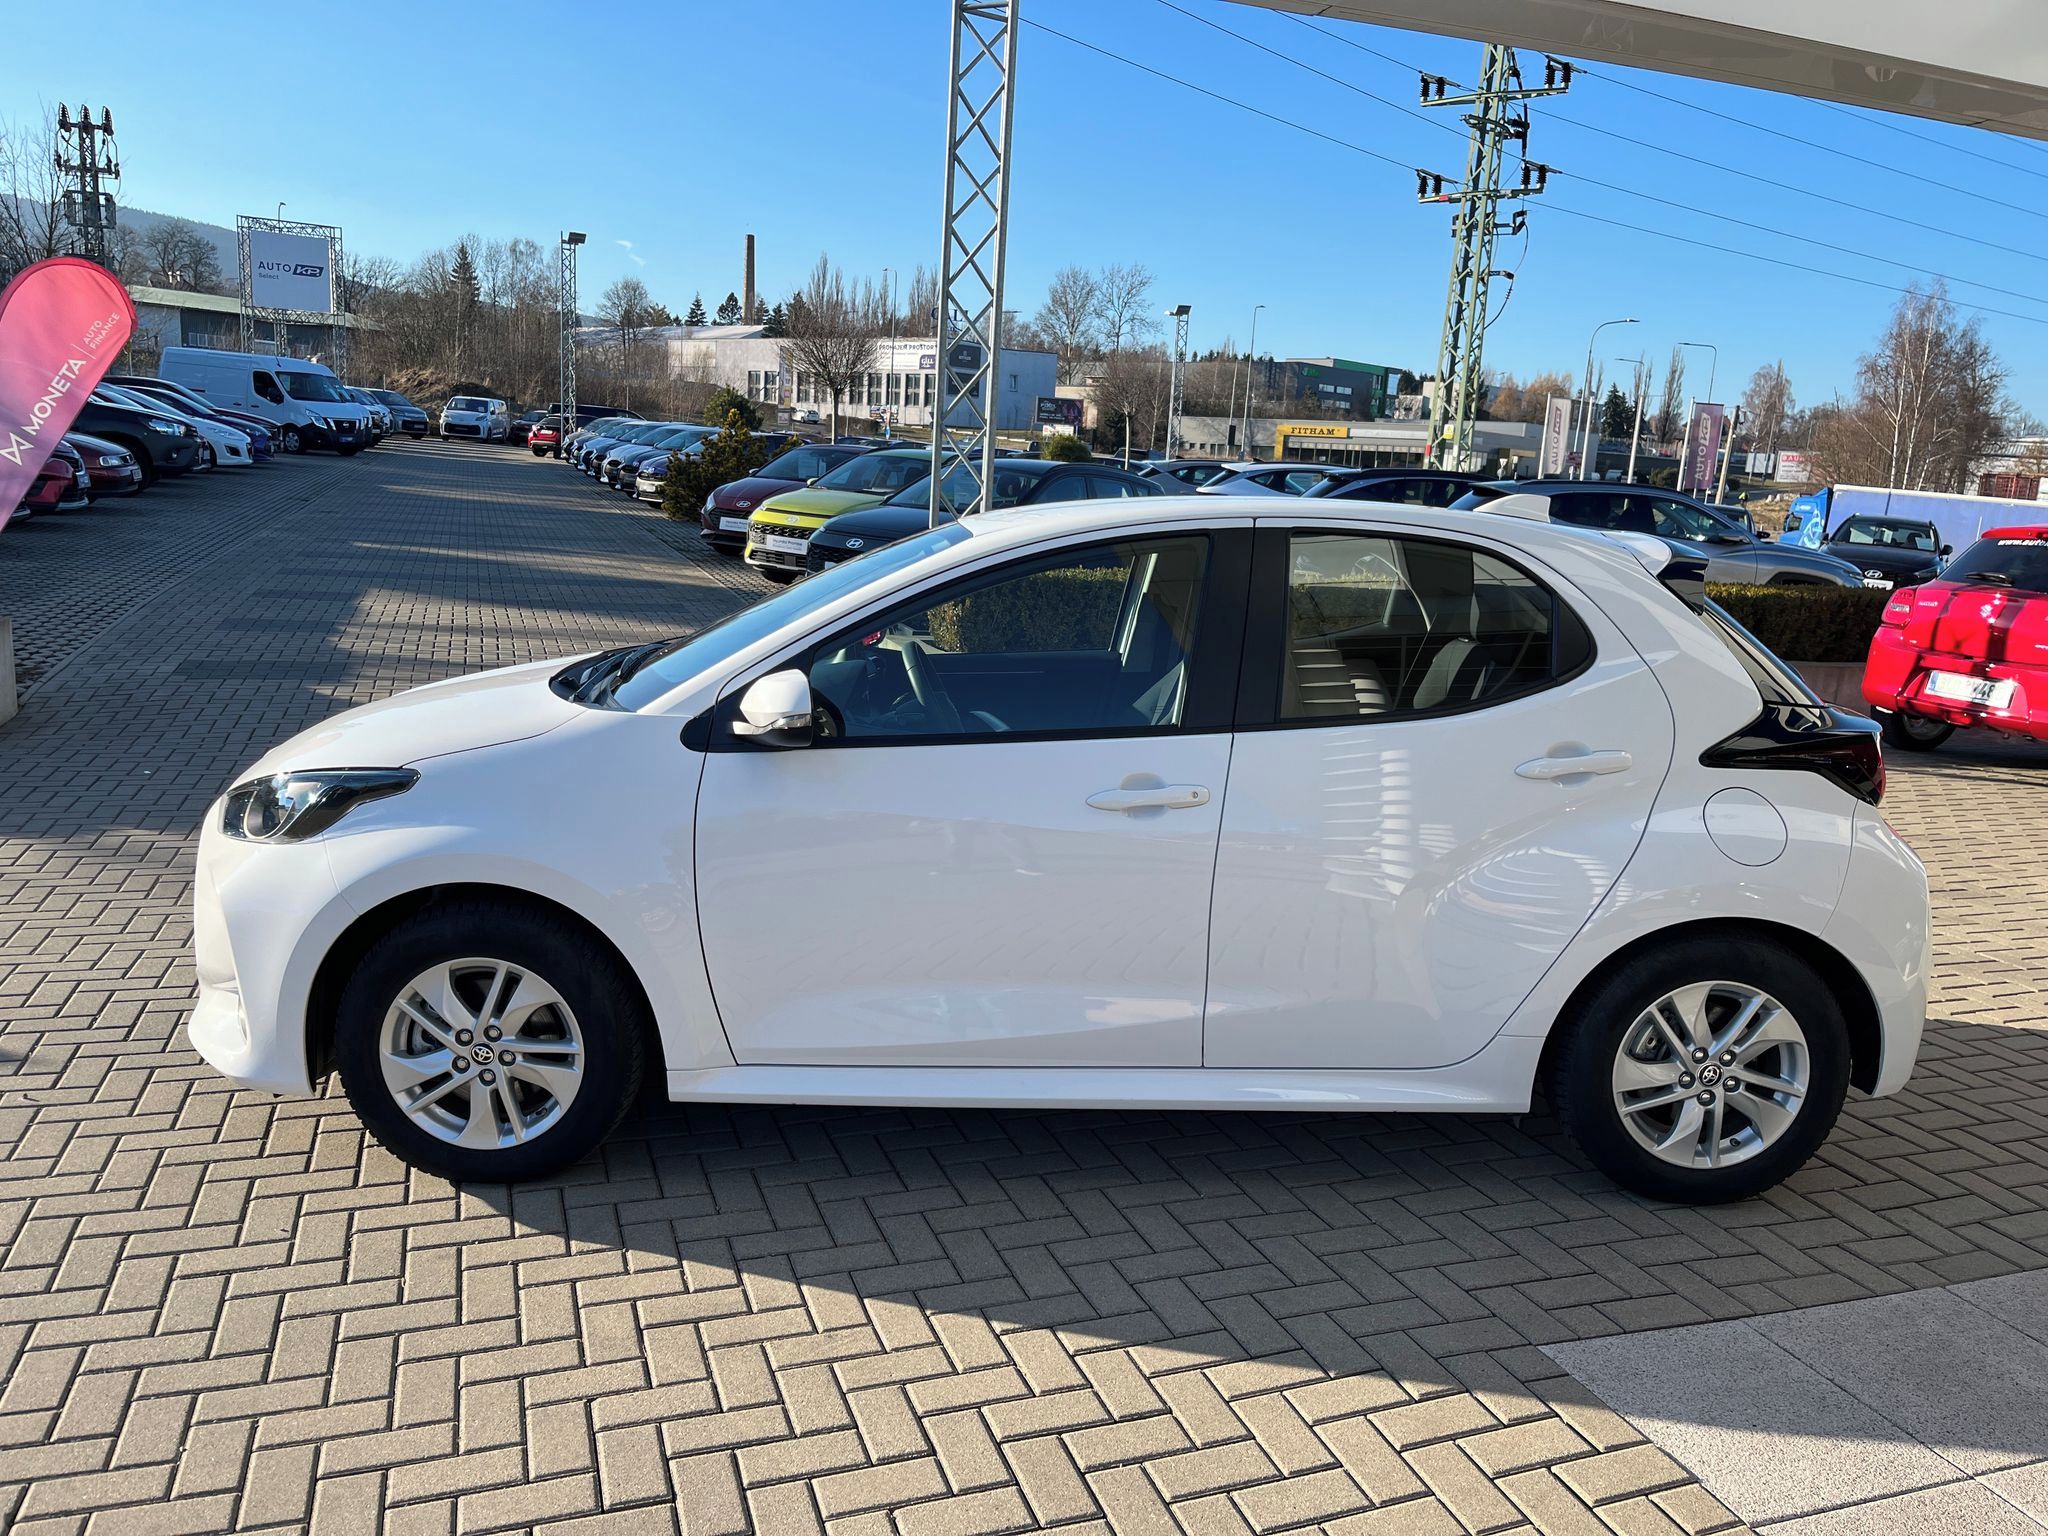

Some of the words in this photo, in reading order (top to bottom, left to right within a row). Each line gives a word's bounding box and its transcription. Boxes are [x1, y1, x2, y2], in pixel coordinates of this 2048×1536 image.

[258, 261, 292, 272] AUTO
[83, 320, 102, 345] AUTO
[89, 312, 120, 350] FINANCE
[21, 359, 87, 435] MONETA
[1290, 427, 1336, 435] FITHAM
[1551, 436, 1559, 465] AUTO
[1694, 446, 1707, 480] AUTO
